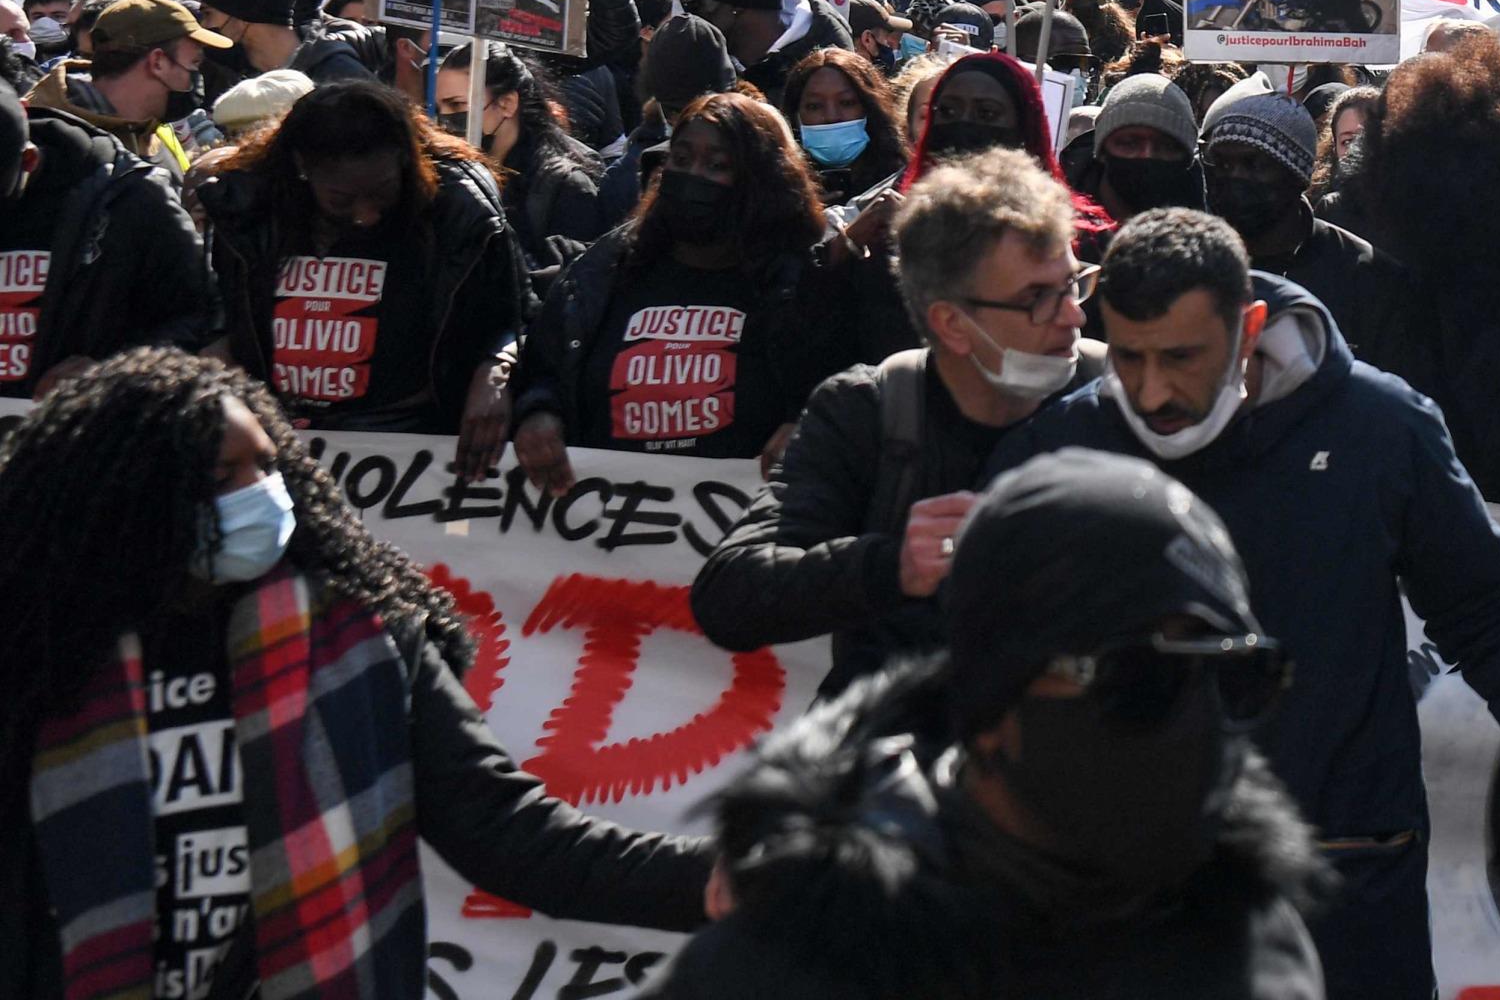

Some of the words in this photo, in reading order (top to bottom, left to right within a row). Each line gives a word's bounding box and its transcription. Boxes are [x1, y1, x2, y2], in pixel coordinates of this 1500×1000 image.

[1217, 33, 1367, 48] @justicepourIbrahimaBah
[273, 317, 361, 353] OLIVIO
[630, 308, 743, 340] JUSTICE
[627, 353, 722, 385] OLIVIO
[624, 397, 720, 434] GOMES
